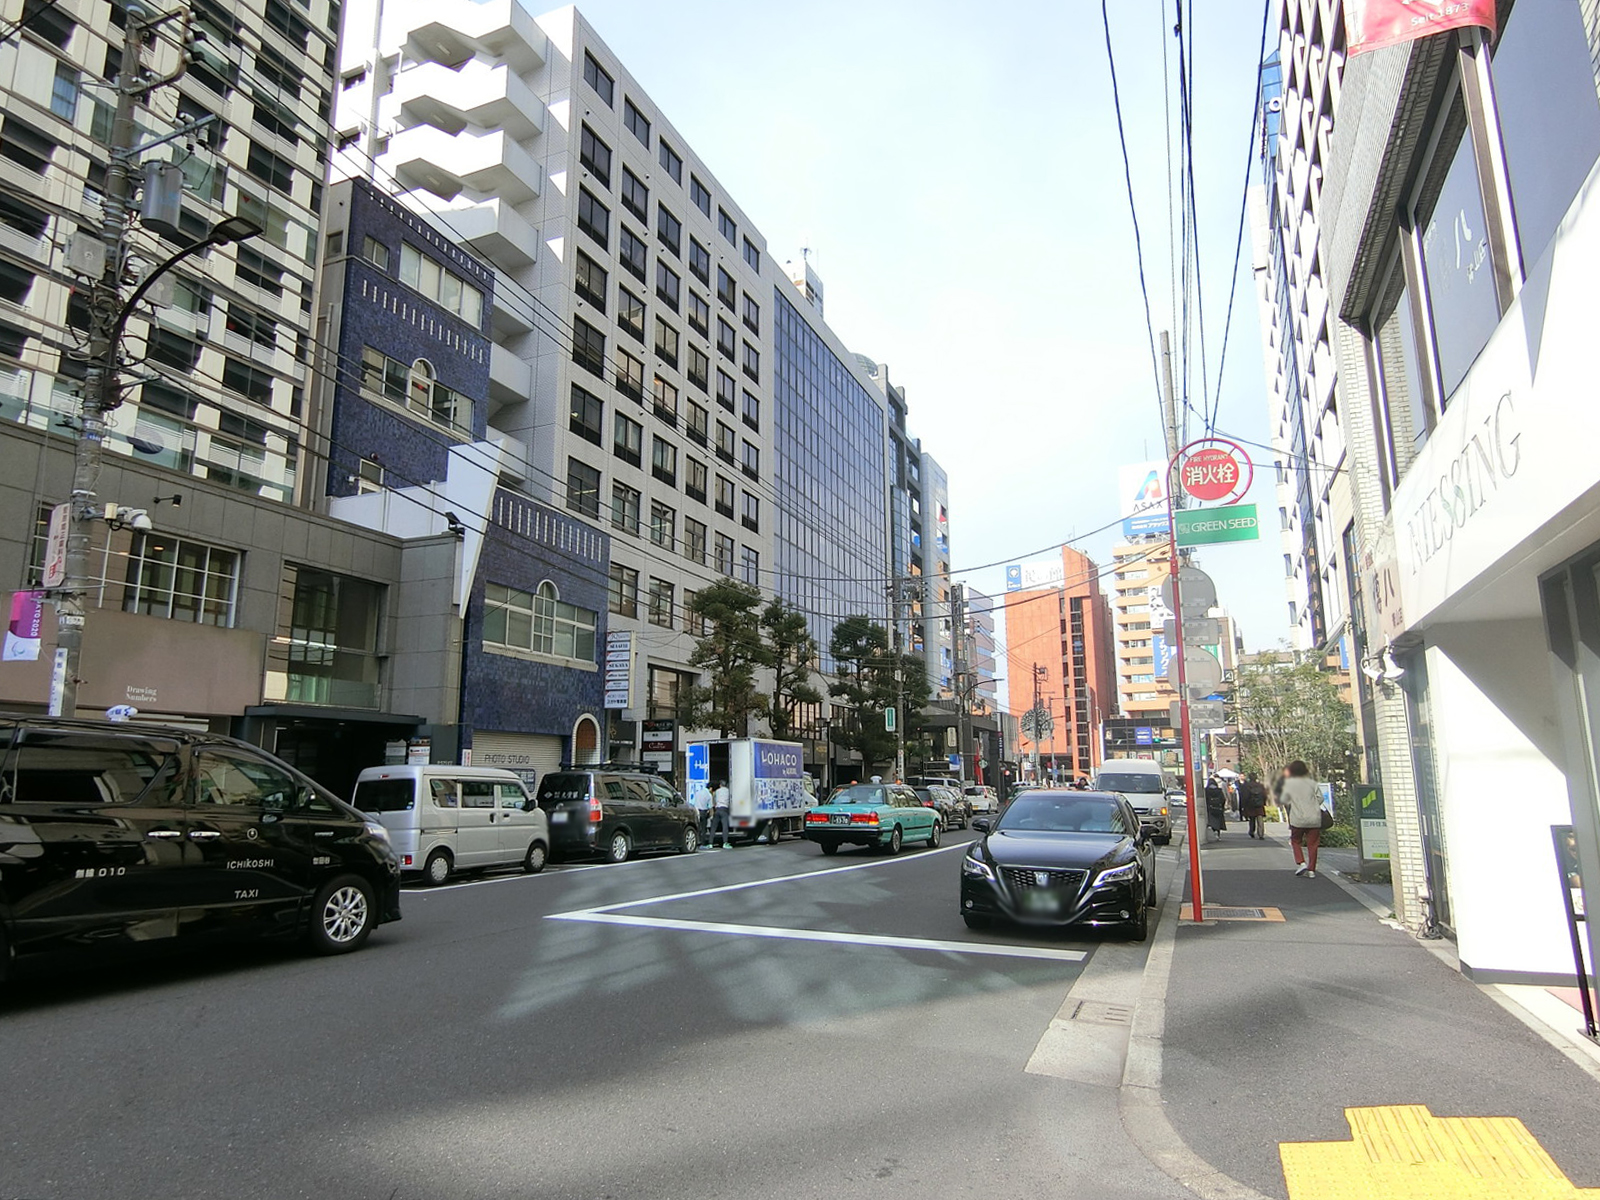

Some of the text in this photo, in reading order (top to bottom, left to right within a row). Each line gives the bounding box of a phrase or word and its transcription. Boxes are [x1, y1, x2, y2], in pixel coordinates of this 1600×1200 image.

[1411, 2, 1469, 26] Seit 1873
[1185, 462, 1235, 487] 消火栓
[1191, 516, 1258, 533] GREEN SEED
[30, 619, 40, 637] 2020
[127, 685, 157, 696] Drawing
[126, 692, 157, 702] Numbers
[484, 754, 531, 764] PHOTO STUDIO
[761, 750, 797, 766] LOHACO
[226, 857, 274, 869] ICHIKOSHI
[98, 866, 126, 877] 010
[234, 889, 259, 899] TAXI
